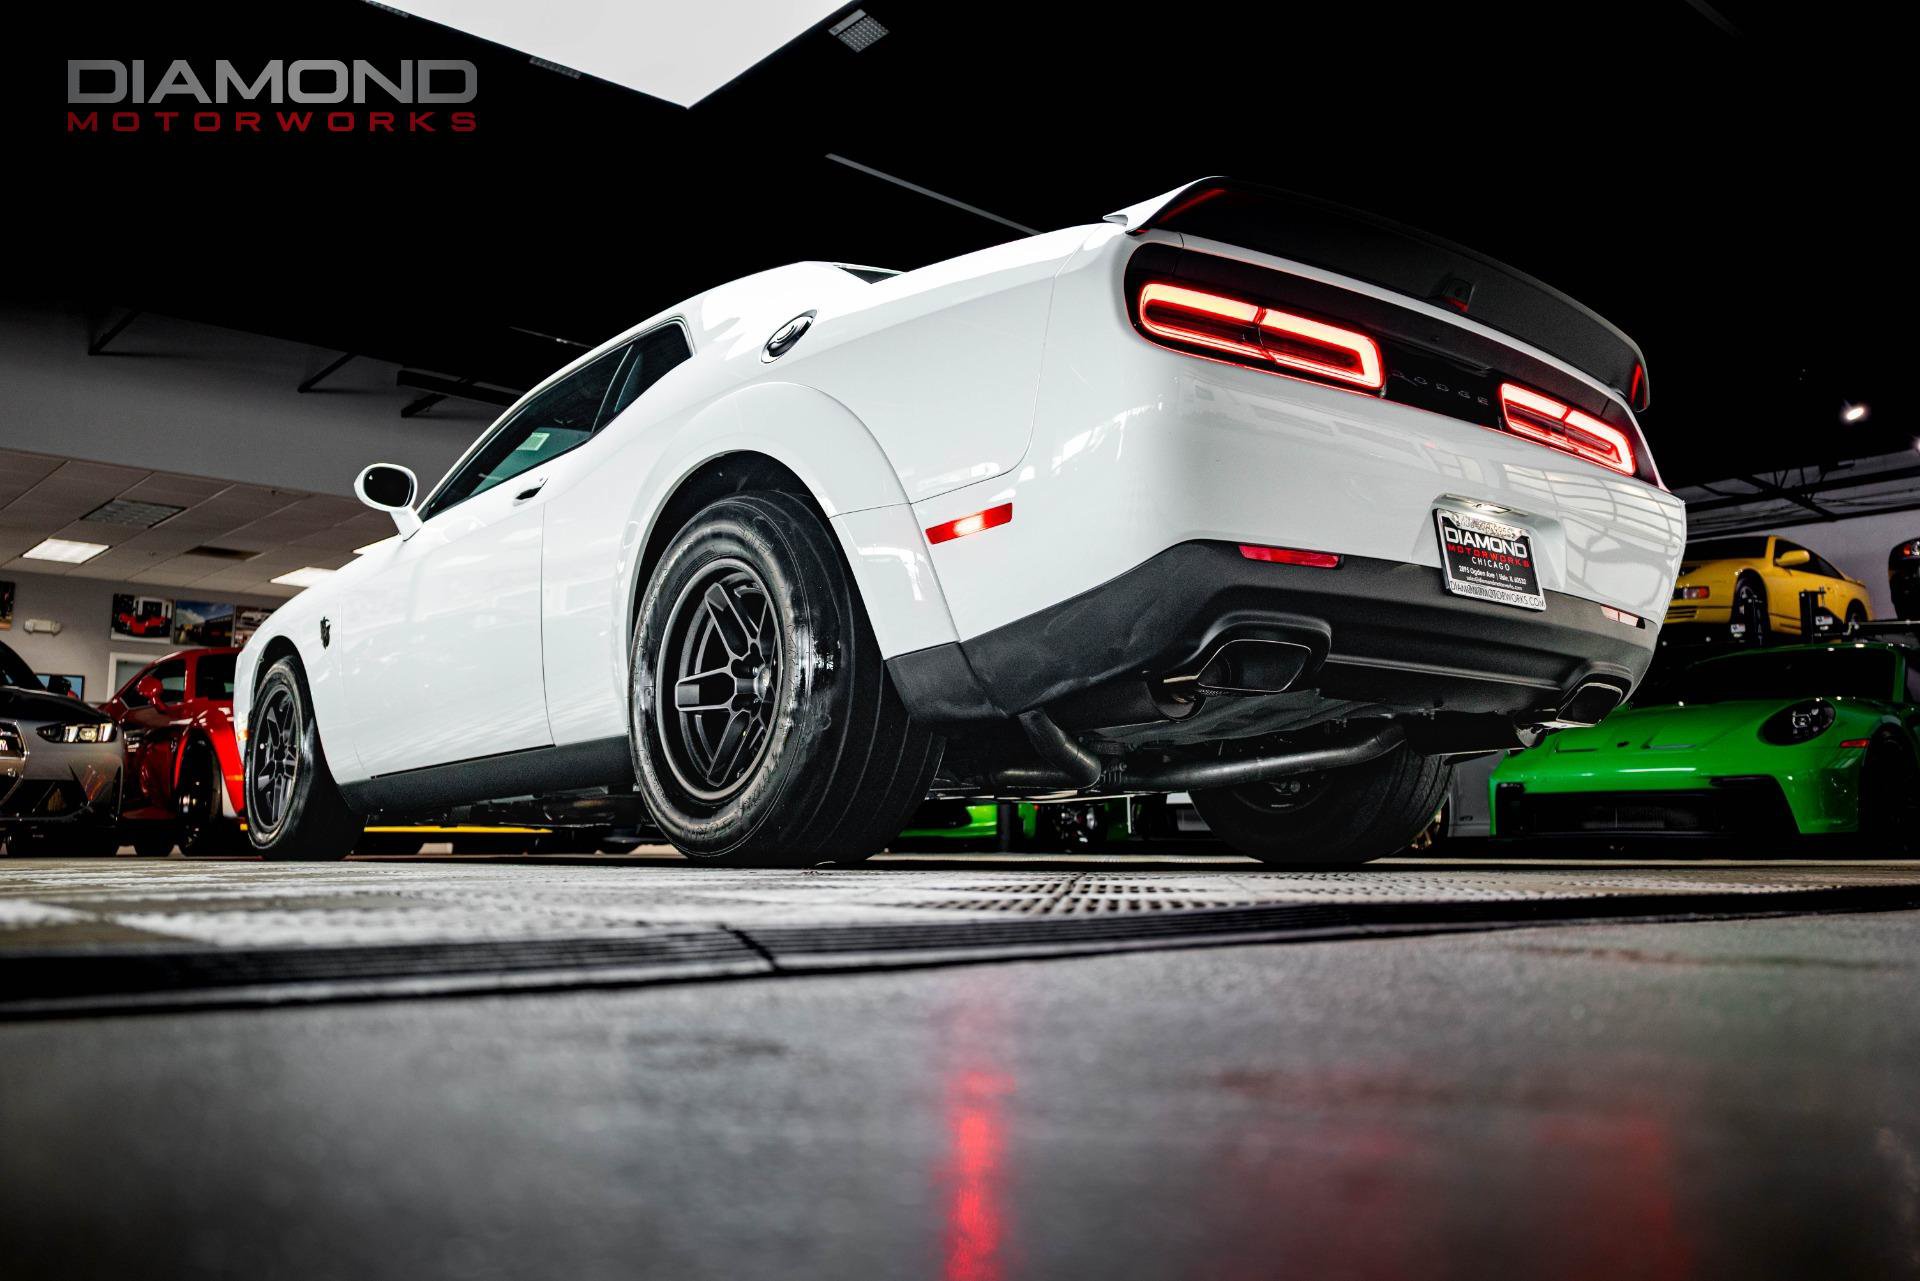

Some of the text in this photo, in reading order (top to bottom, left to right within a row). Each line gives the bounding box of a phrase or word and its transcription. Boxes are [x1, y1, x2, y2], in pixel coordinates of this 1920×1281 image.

[1444, 526, 1528, 558] DIAMOND
[1447, 543, 1530, 568] MOTORWORKS
[1471, 556, 1510, 571] CHICAGO
